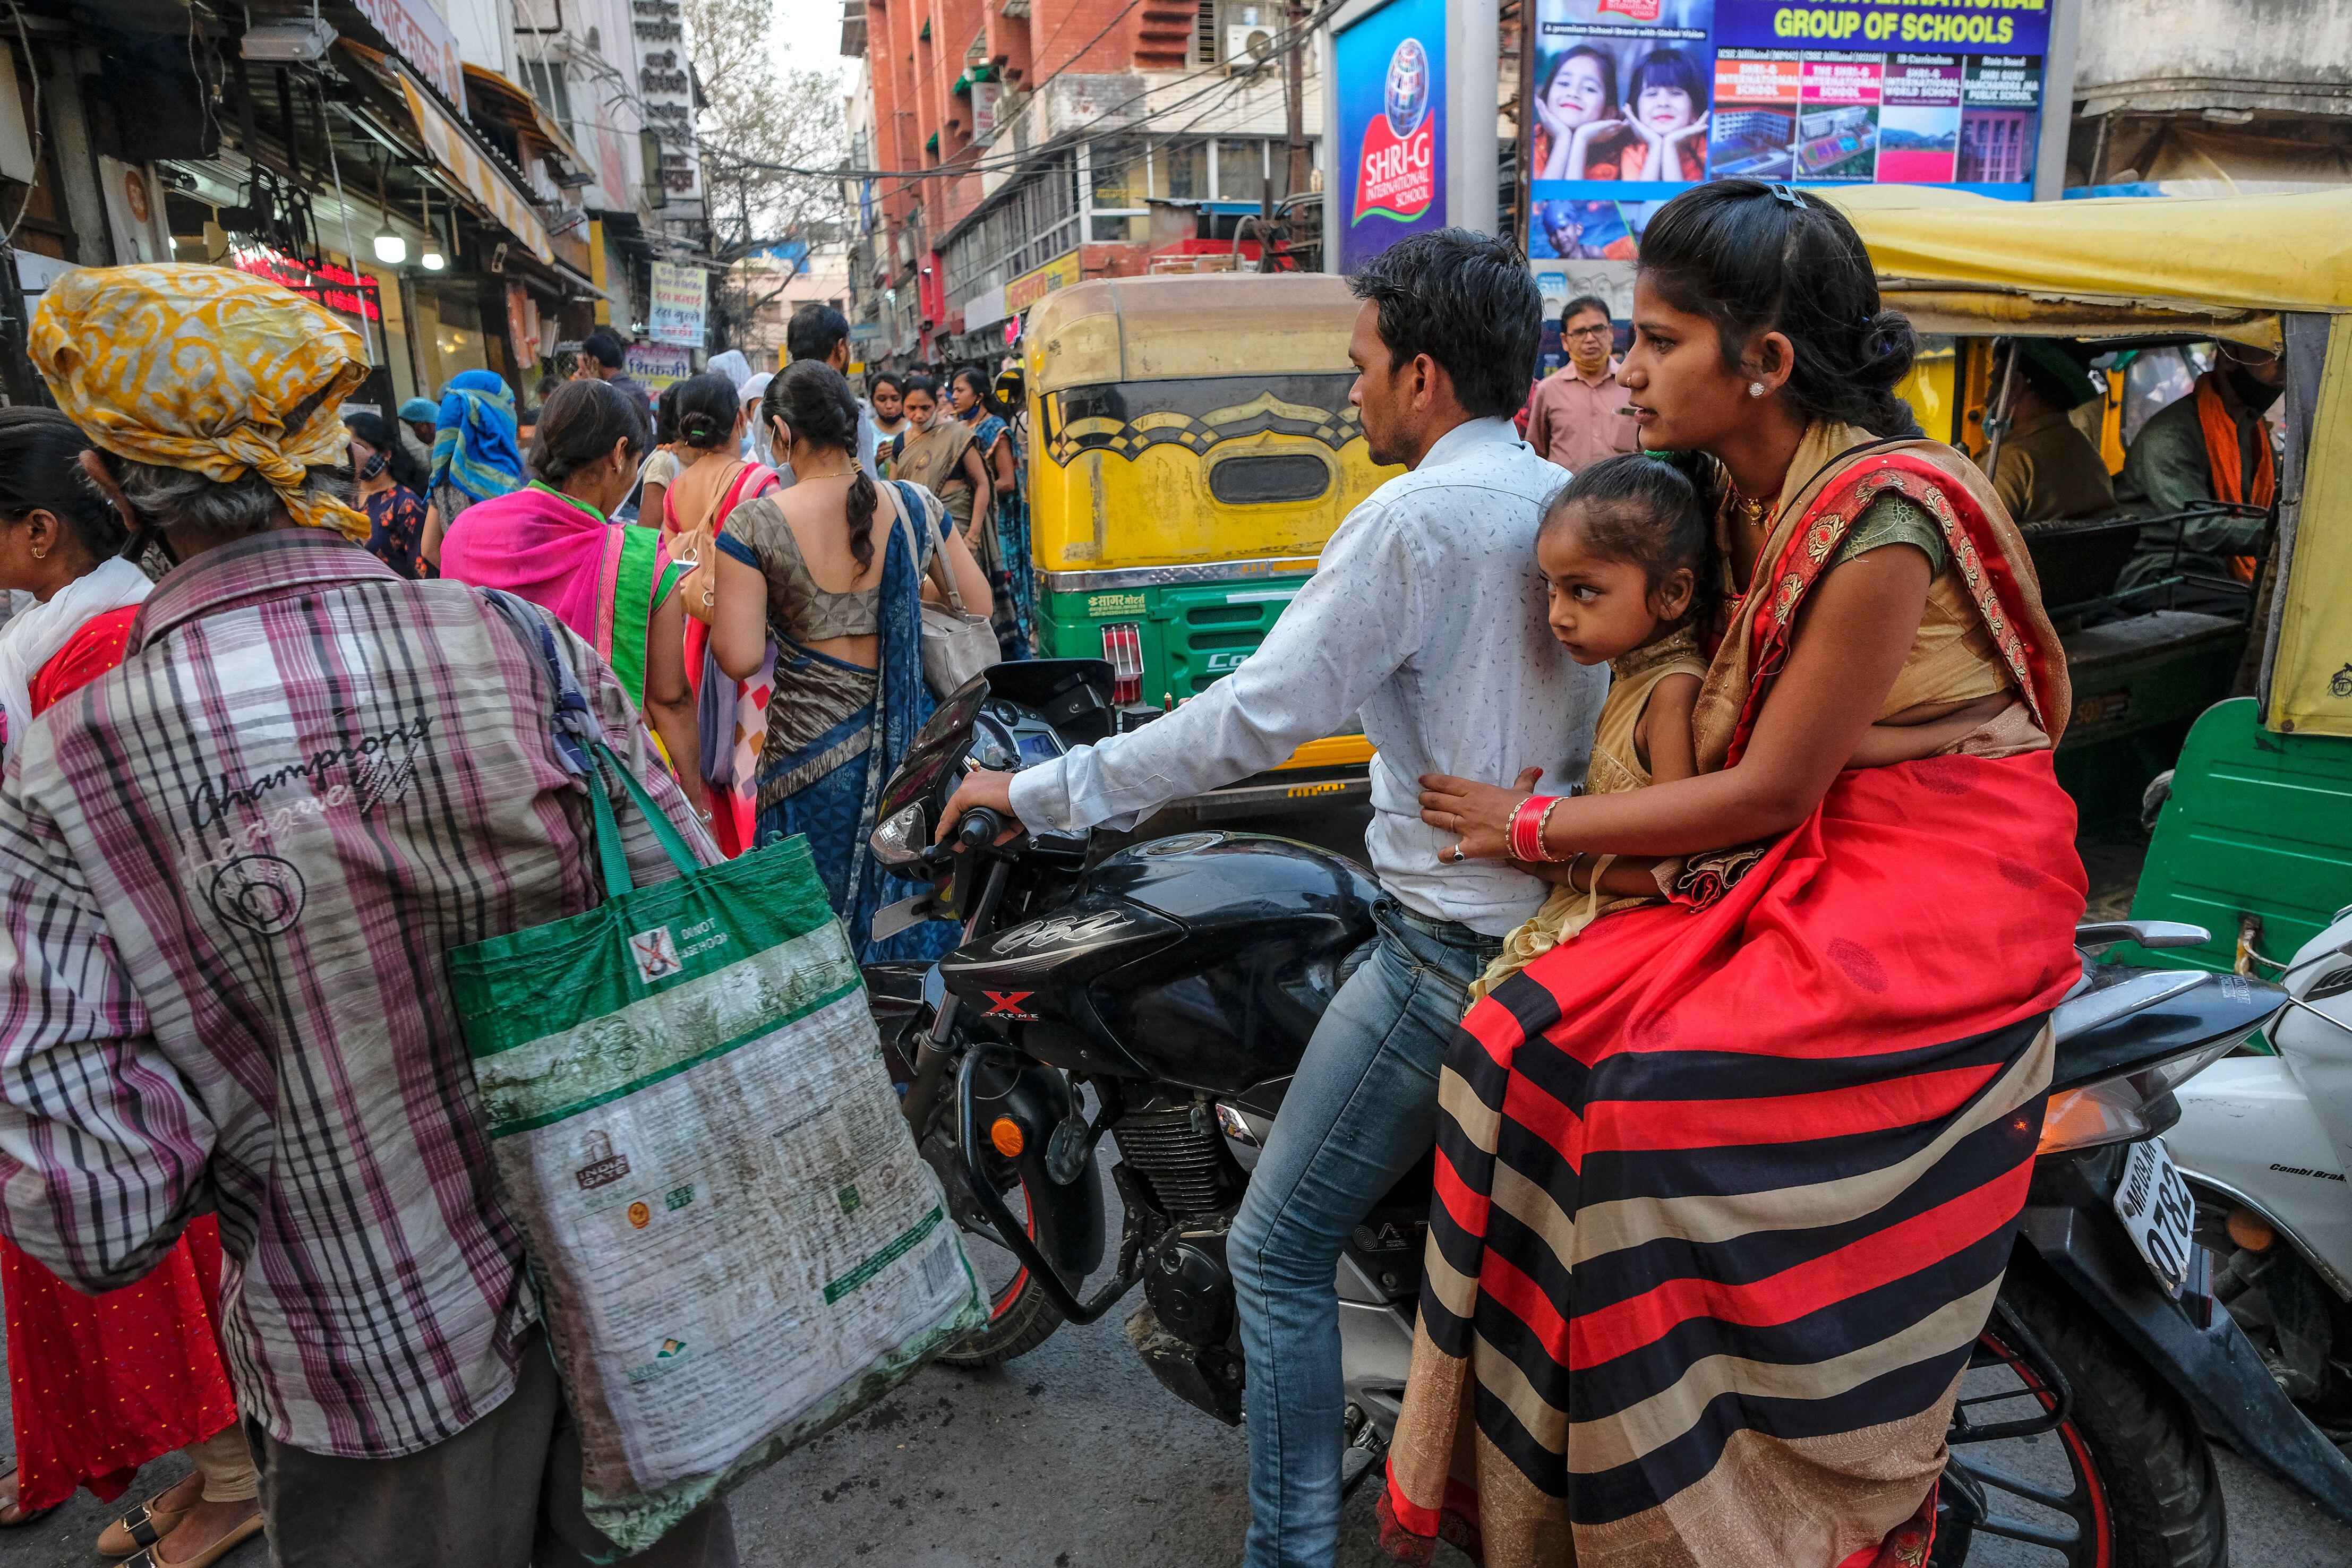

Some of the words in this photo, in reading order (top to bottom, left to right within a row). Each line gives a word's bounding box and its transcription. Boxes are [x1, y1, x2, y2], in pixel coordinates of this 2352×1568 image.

[1552, 25, 1587, 33] premium
[1615, 27, 1638, 36] Brand
[1639, 28, 1655, 36] with
[1656, 28, 1680, 37] Global
[1681, 30, 1706, 39] Vision
[1774, 8, 1861, 38] GROUP
[1864, 12, 1900, 40] OF
[1901, 13, 2014, 44] SCHOOLS
[1716, 73, 1800, 85] INTERNATIONAL
[1803, 75, 1880, 88] INTERNATIONAL
[1885, 77, 1960, 88] INTERNATIONAL
[1735, 84, 1778, 96] SCHOOL
[1820, 86, 1861, 98] SCHOOL
[1920, 87, 1960, 98] SCHOOL
[1999, 90, 2032, 101] SCHOOL
[1365, 132, 1430, 186] SHRI-G
[1366, 168, 1430, 201] INTERNATIONAL
[1395, 185, 1430, 208] SCHOOL
[656, 291, 671, 302] रस
[655, 306, 672, 319] रस
[629, 357, 687, 378] शिकंजी
[1098, 594, 1124, 606] सागर
[191, 716, 433, 829] Champions
[991, 909, 1136, 955] CBZ
[579, 1155, 626, 1180] INDIA
[2269, 1163, 2314, 1176] Combi
[583, 1163, 628, 1187] GATE
[2146, 1161, 2192, 1287] 0782
